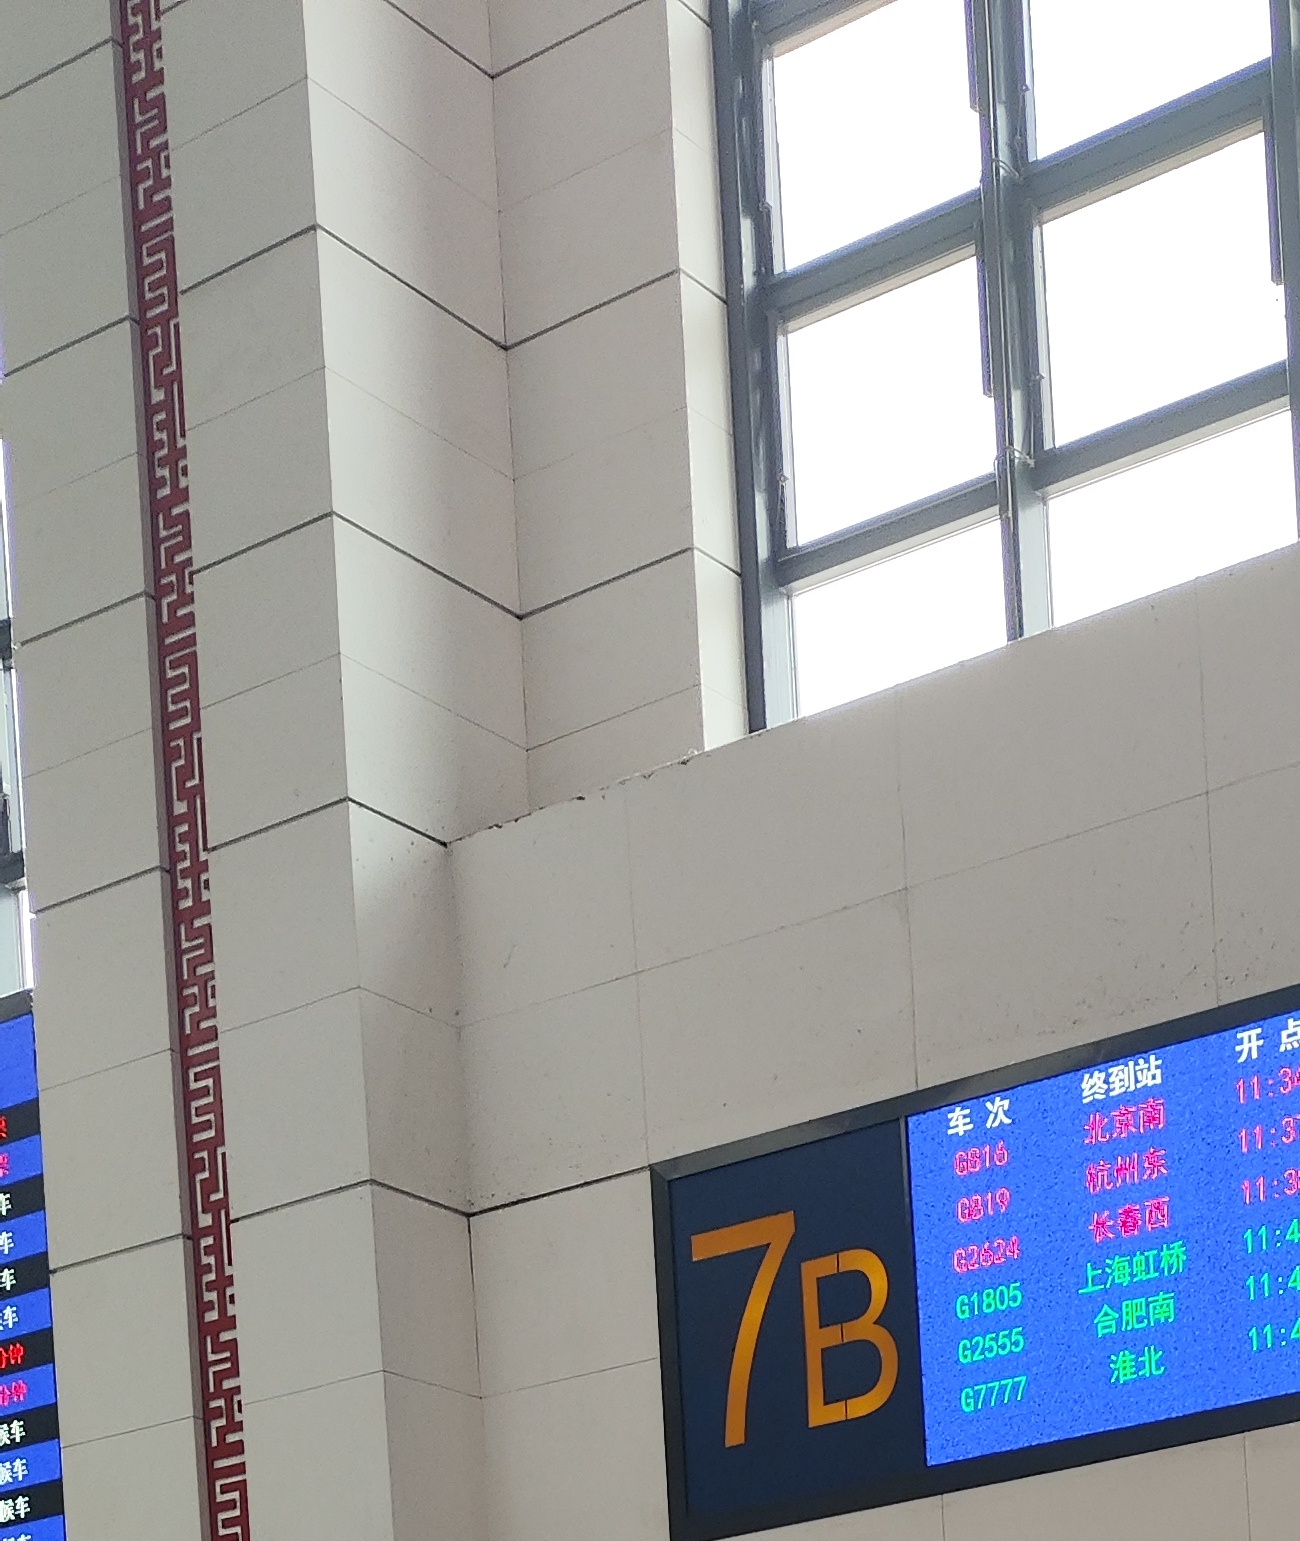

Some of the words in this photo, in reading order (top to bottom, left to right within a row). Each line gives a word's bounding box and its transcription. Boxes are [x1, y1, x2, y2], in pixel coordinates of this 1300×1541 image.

[948, 1097, 1012, 1136] 车次
[1081, 1056, 1164, 1104] 终到站
[1083, 1097, 1166, 1144] 北京南
[1086, 1147, 1167, 1194] 杭州东
[957, 1282, 1021, 1319] G1805
[1079, 1238, 1186, 1297] 上海虹桥
[691, 1210, 900, 1448] 7B
[959, 1327, 1024, 1363] G2555
[1092, 1290, 1174, 1337] 合肥南
[961, 1376, 1026, 1412] G7777
[1110, 1346, 1164, 1383] 淮北
